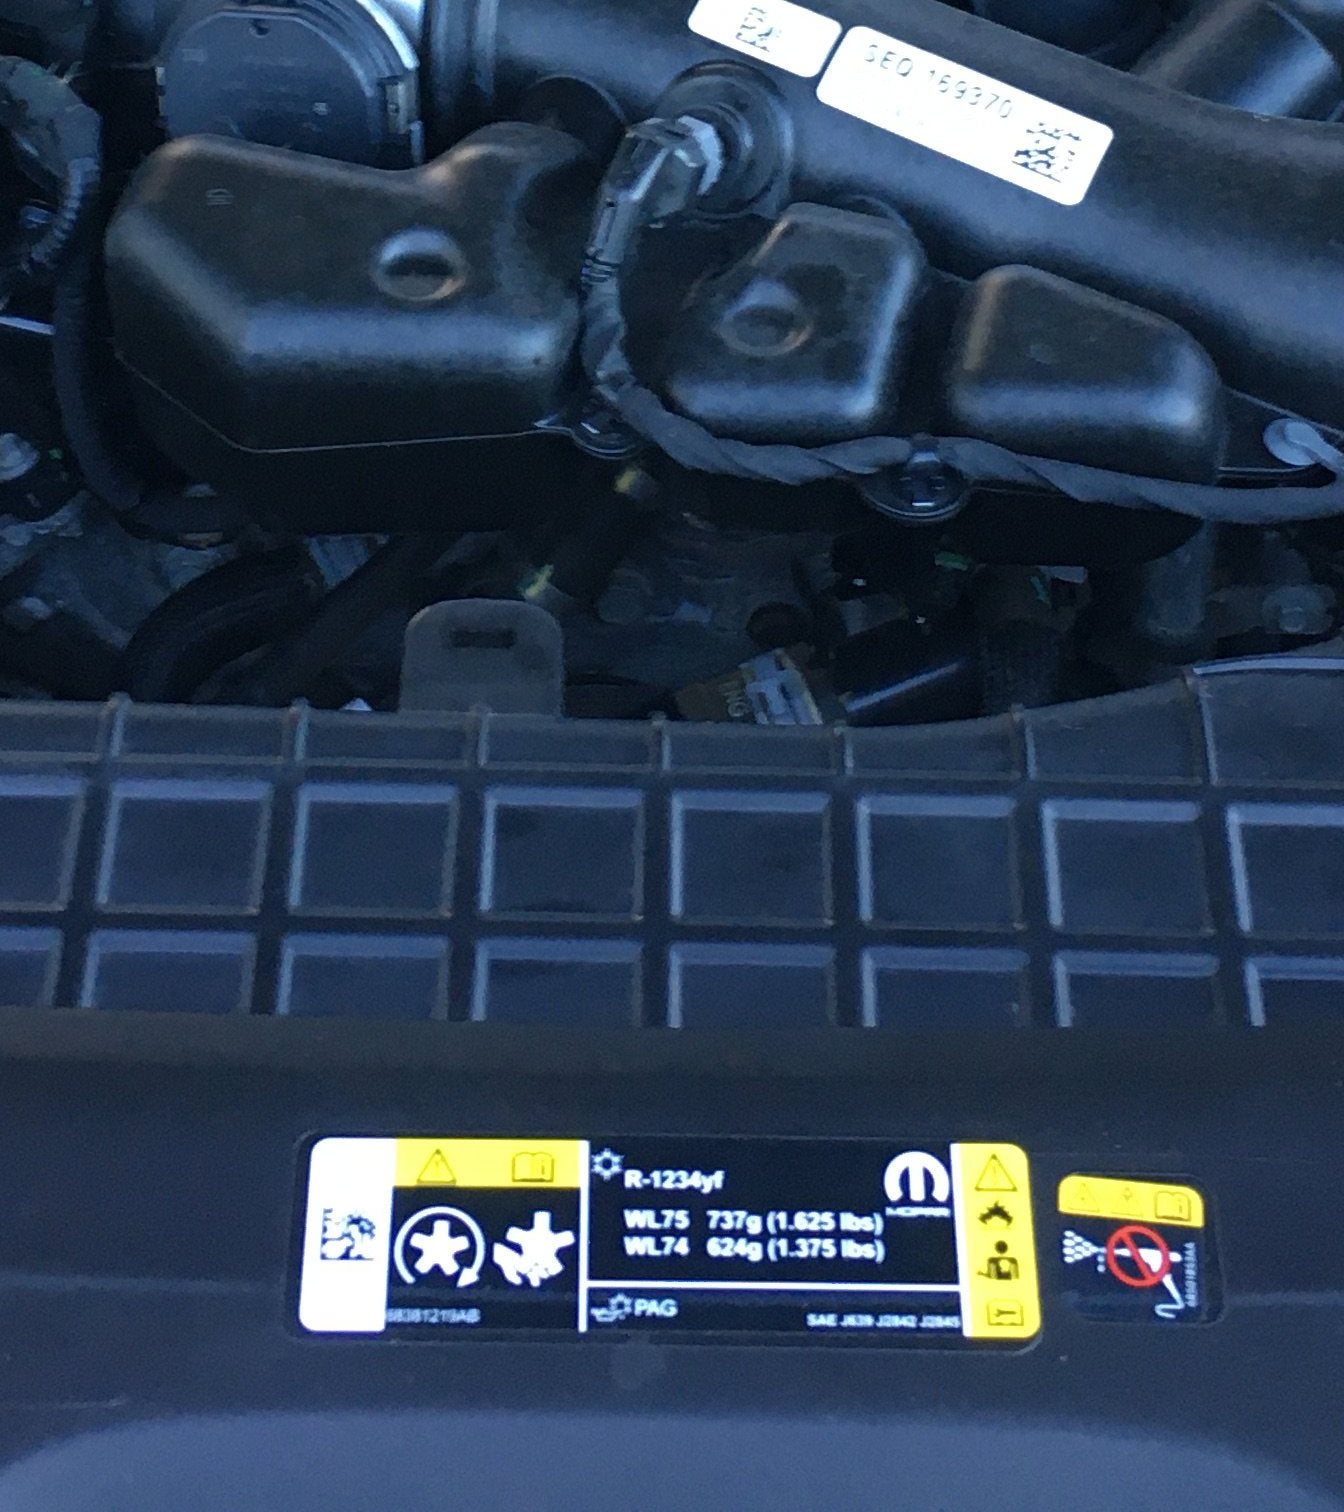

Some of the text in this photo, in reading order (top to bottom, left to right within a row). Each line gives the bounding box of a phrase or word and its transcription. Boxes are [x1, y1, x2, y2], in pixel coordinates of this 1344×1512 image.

[624, 1169, 725, 1194] R-1234yf
[623, 1209, 884, 1237] WL75 737g (1.625 lbs)
[623, 1236, 885, 1264] WL74 624g (1.375 lbs)
[633, 1299, 679, 1318] PAG
[806, 1312, 838, 1328] SAE
